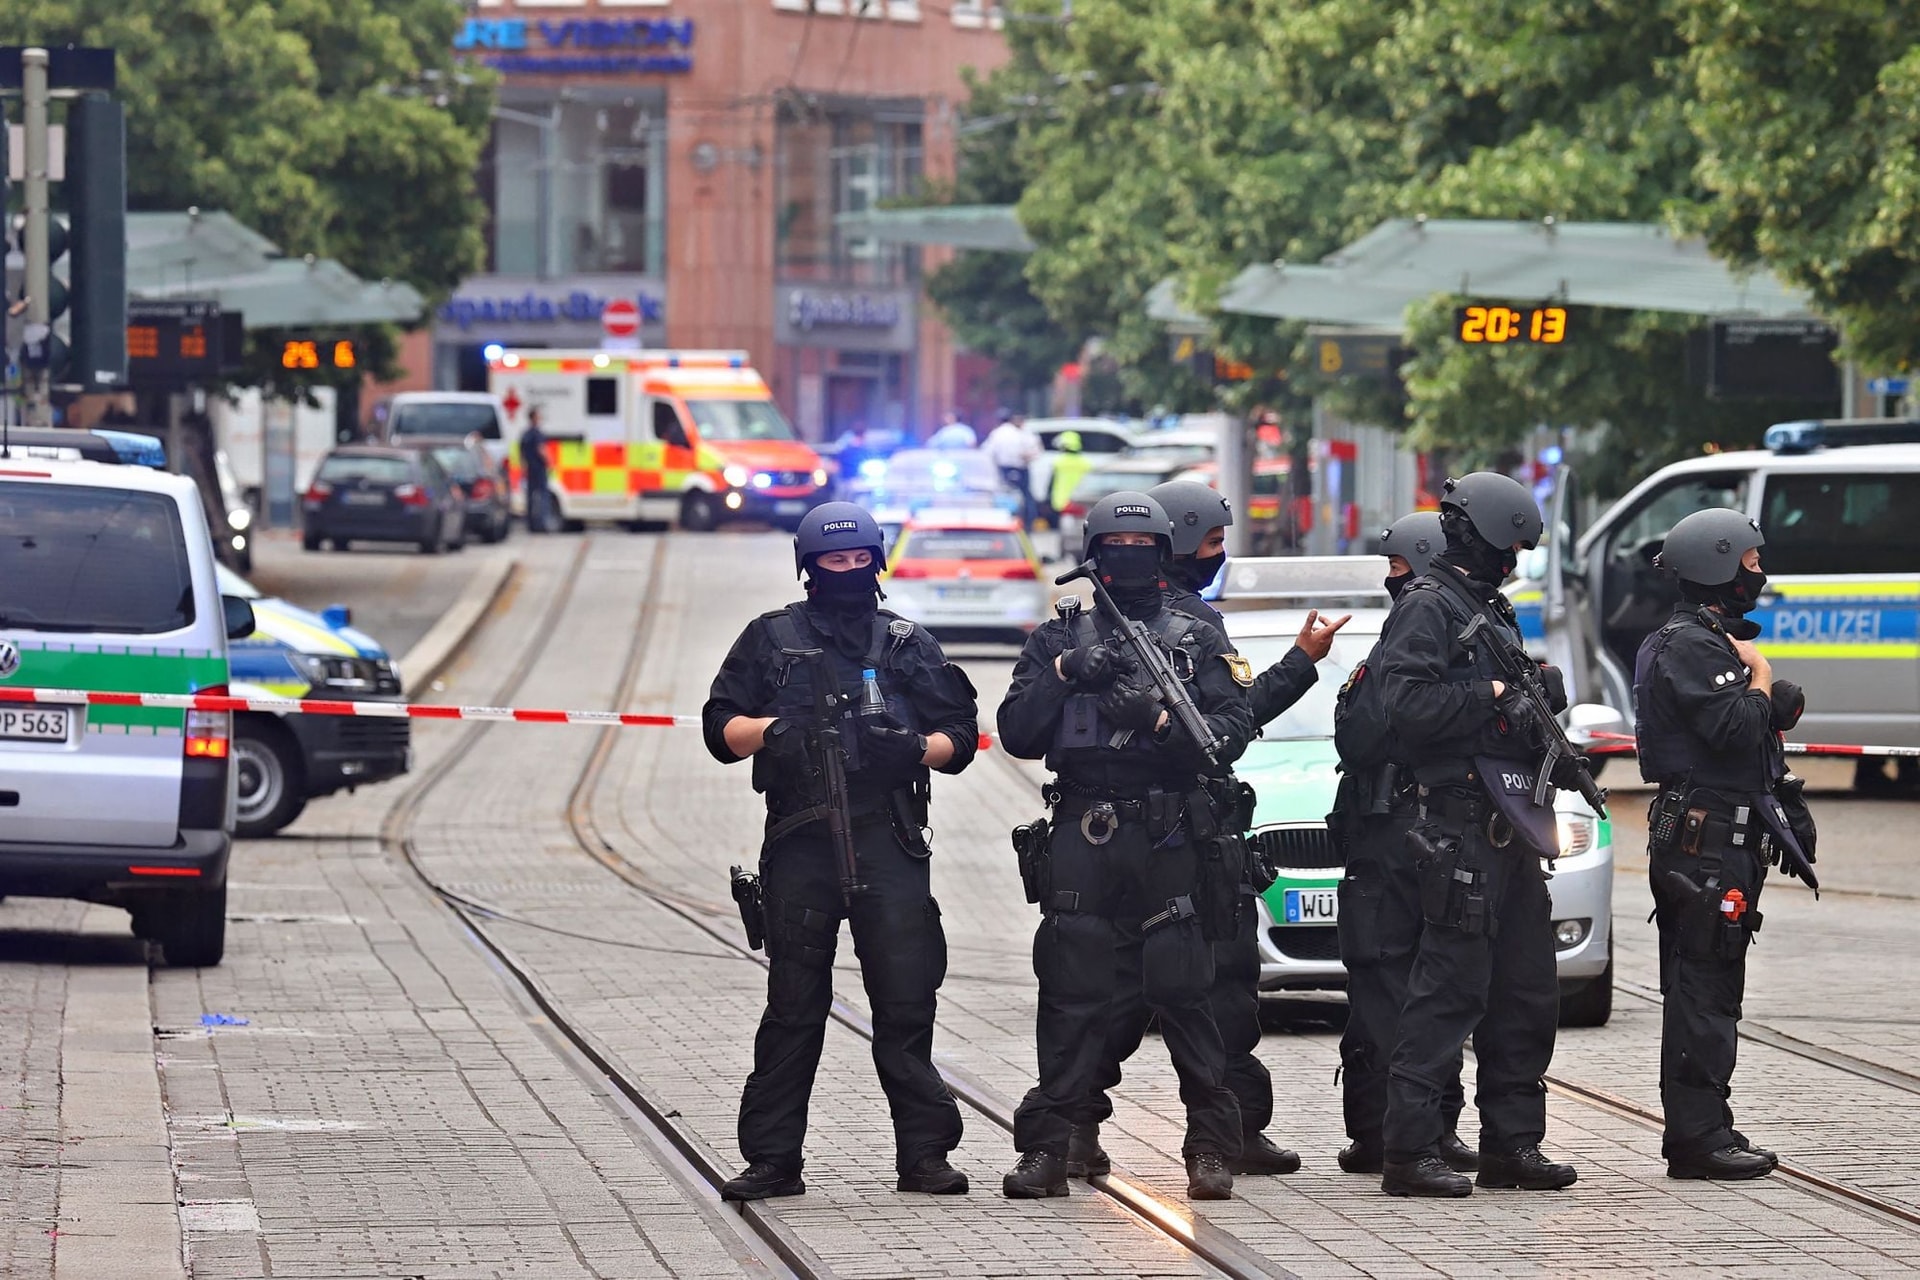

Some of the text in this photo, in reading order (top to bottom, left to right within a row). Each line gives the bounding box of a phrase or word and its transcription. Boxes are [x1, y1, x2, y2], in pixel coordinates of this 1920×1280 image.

[1116, 506, 1149, 514] POLIZEI
[823, 521, 857, 531] POLIZEI
[1773, 610, 1882, 643] POLIZEI
[22, 713, 63, 734] 563
